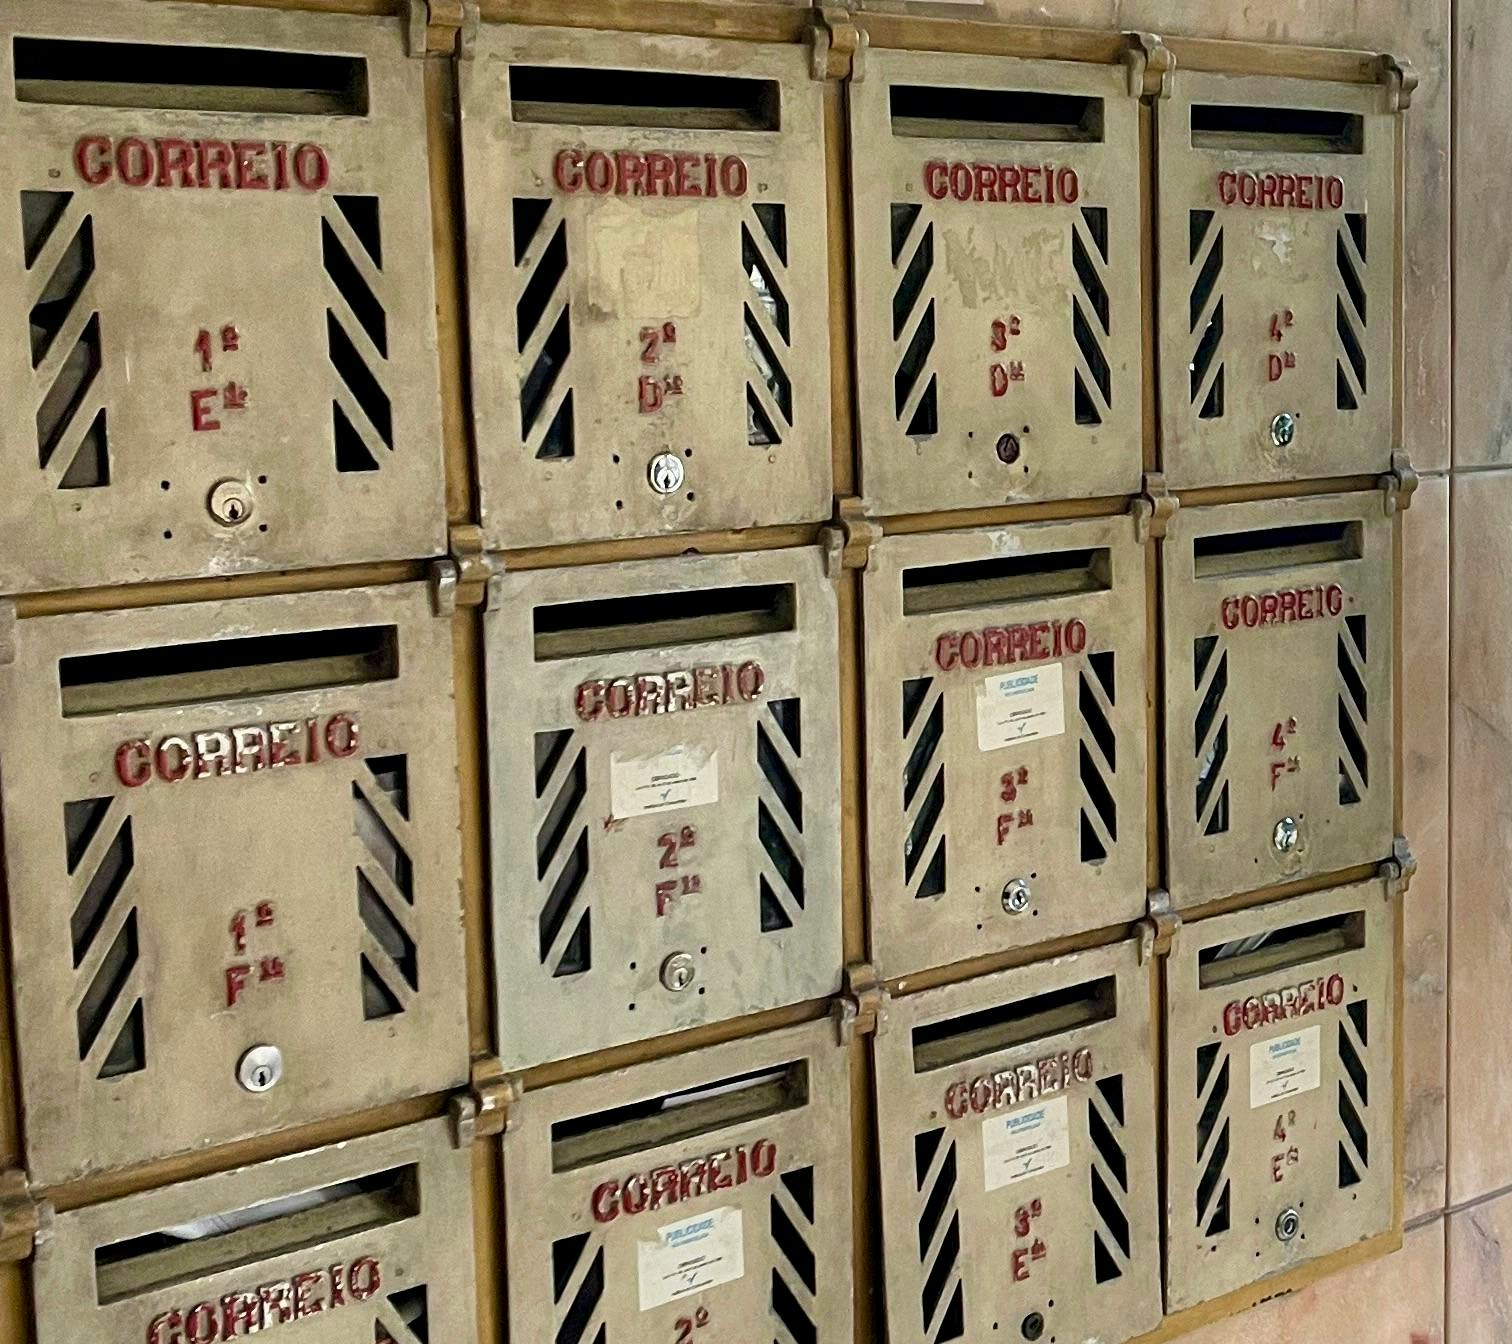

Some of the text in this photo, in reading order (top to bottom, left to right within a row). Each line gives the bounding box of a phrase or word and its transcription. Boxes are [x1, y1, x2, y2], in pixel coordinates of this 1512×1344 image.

[74, 134, 330, 191] CORREIO
[554, 148, 748, 198] CORREIO
[924, 160, 1079, 204] CORREIO
[1217, 170, 1345, 209] CORREIO
[1221, 583, 1343, 630] CORREIO
[936, 617, 1087, 672] CORREIO
[574, 659, 765, 722] CORREIO
[115, 712, 360, 788] CORREIO
[1222, 972, 1345, 1037] CORREIO
[944, 1047, 1094, 1120] CORREIO
[590, 1138, 777, 1224] CORREIO
